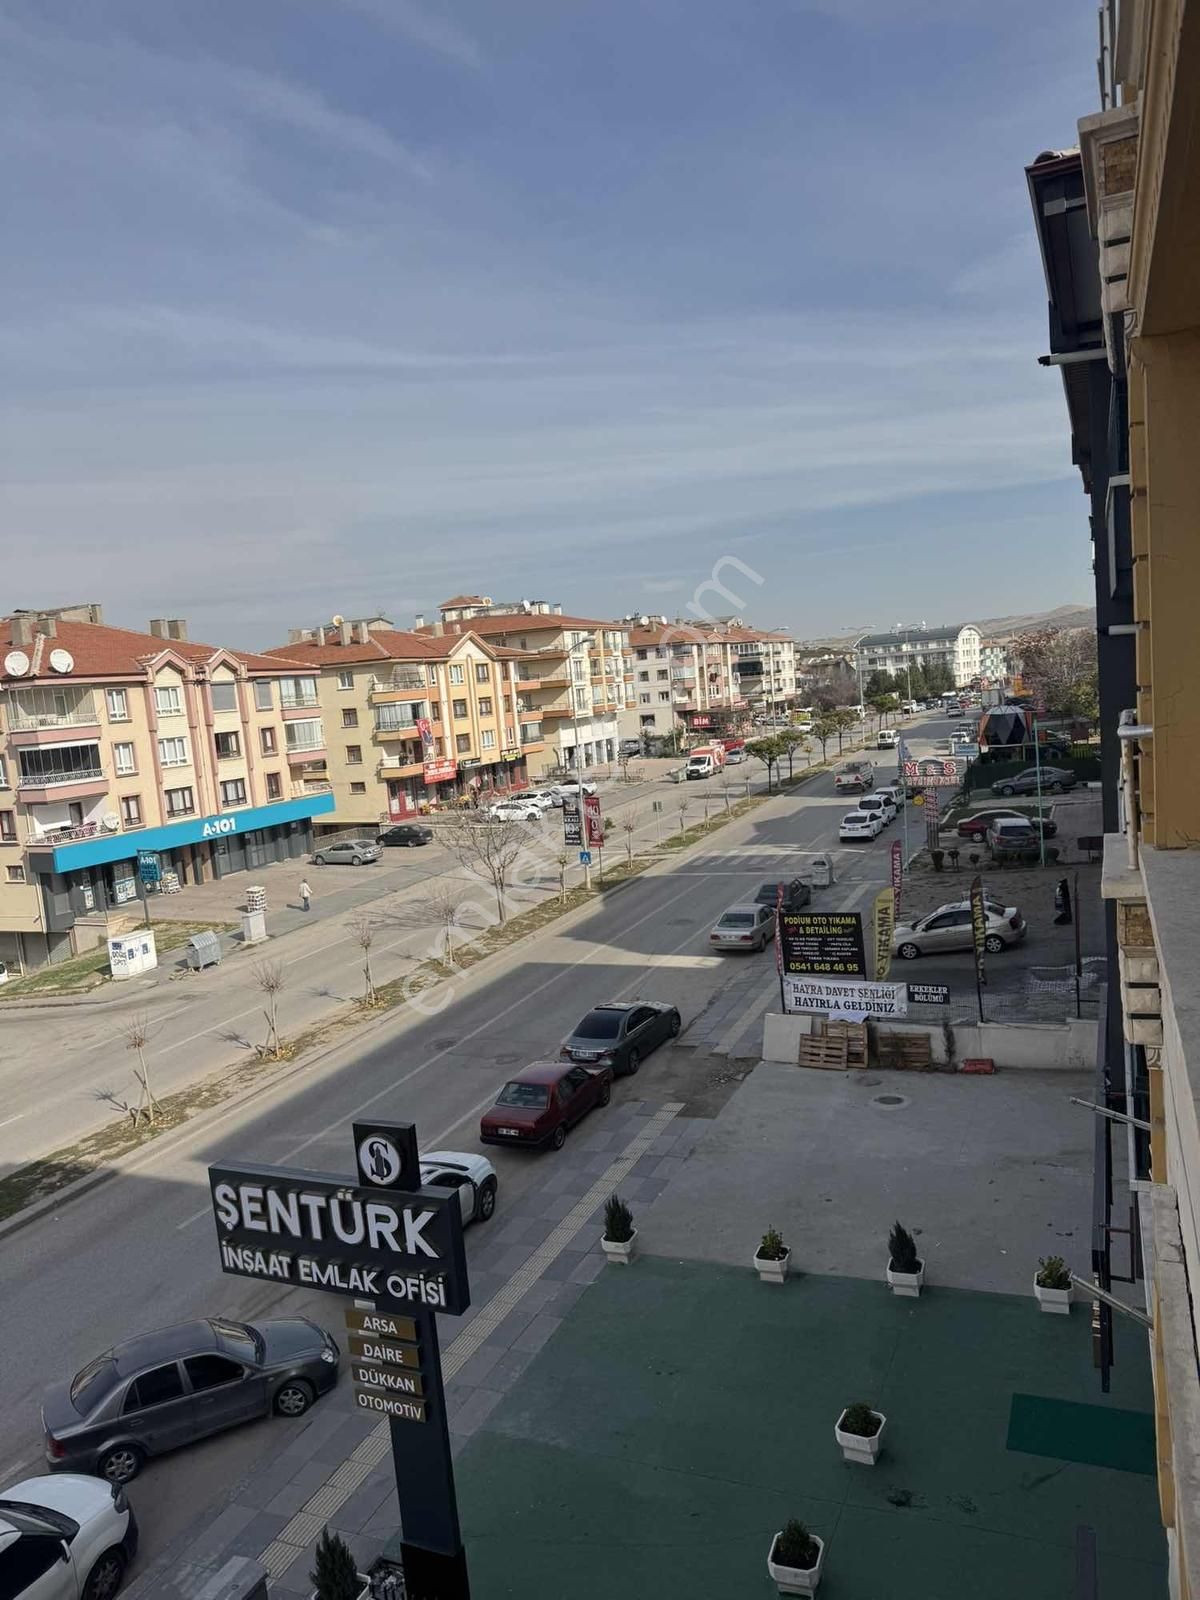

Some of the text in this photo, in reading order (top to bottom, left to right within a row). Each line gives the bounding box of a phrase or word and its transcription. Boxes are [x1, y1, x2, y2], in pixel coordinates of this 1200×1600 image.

[693, 716, 709, 725] BİM
[903, 761, 957, 776] M & S
[893, 852, 901, 894] YIKAMA
[784, 915, 857, 926] PODİUM OTO YIKAMA
[972, 895, 986, 953] YIKAMA
[877, 906, 891, 961] YIKAMA
[789, 962, 811, 971] 0541
[814, 963, 831, 971] 648
[846, 964, 859, 972] 95
[793, 983, 823, 996] HAYRA
[825, 985, 857, 998] DAVET
[909, 984, 948, 994] ERKEKLER
[914, 993, 944, 1003] BÖLÜMÜ
[794, 996, 895, 1013] HAYIRLA GELDİNİZ
[215, 1183, 440, 1259] ŞENTÜRK
[222, 1241, 446, 1306] İNŞAAT EMLAK OFİSİ
[363, 1316, 398, 1334] ARSA
[364, 1343, 403, 1363] DAİRE
[359, 1368, 415, 1392] DÜKKAN
[358, 1394, 422, 1420] OTOMOTİV
